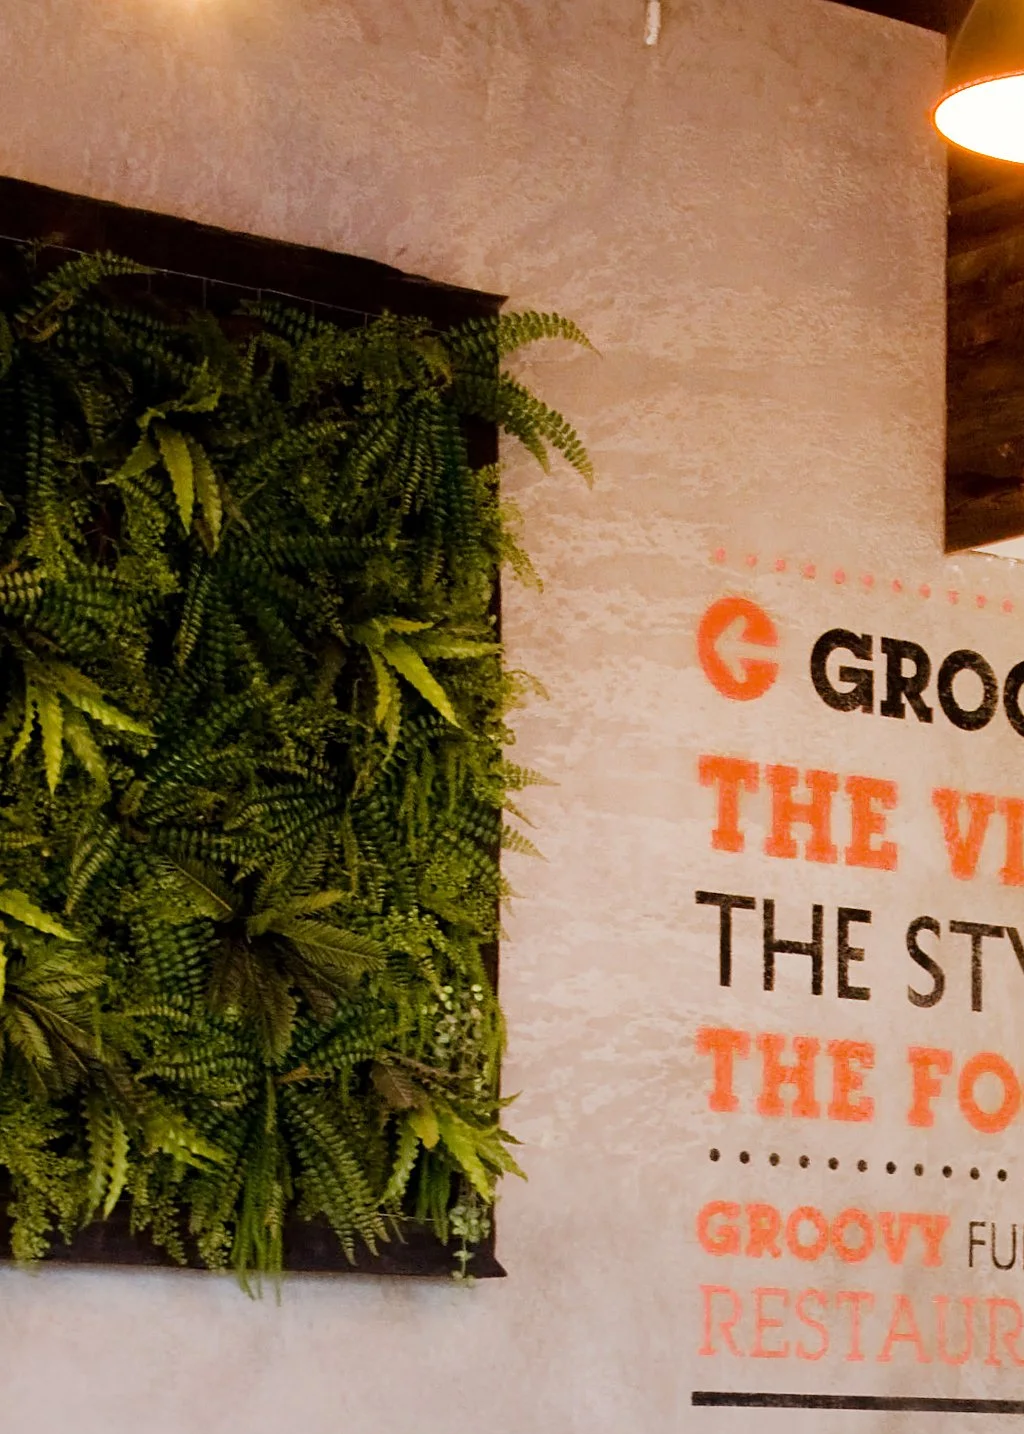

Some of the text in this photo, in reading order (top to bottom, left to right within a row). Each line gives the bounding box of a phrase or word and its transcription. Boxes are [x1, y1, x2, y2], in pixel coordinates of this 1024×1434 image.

[698, 755, 897, 870] THE
[695, 891, 872, 1000] THE
[697, 1028, 873, 1122] THE
[697, 1201, 949, 1266] GROOVY
